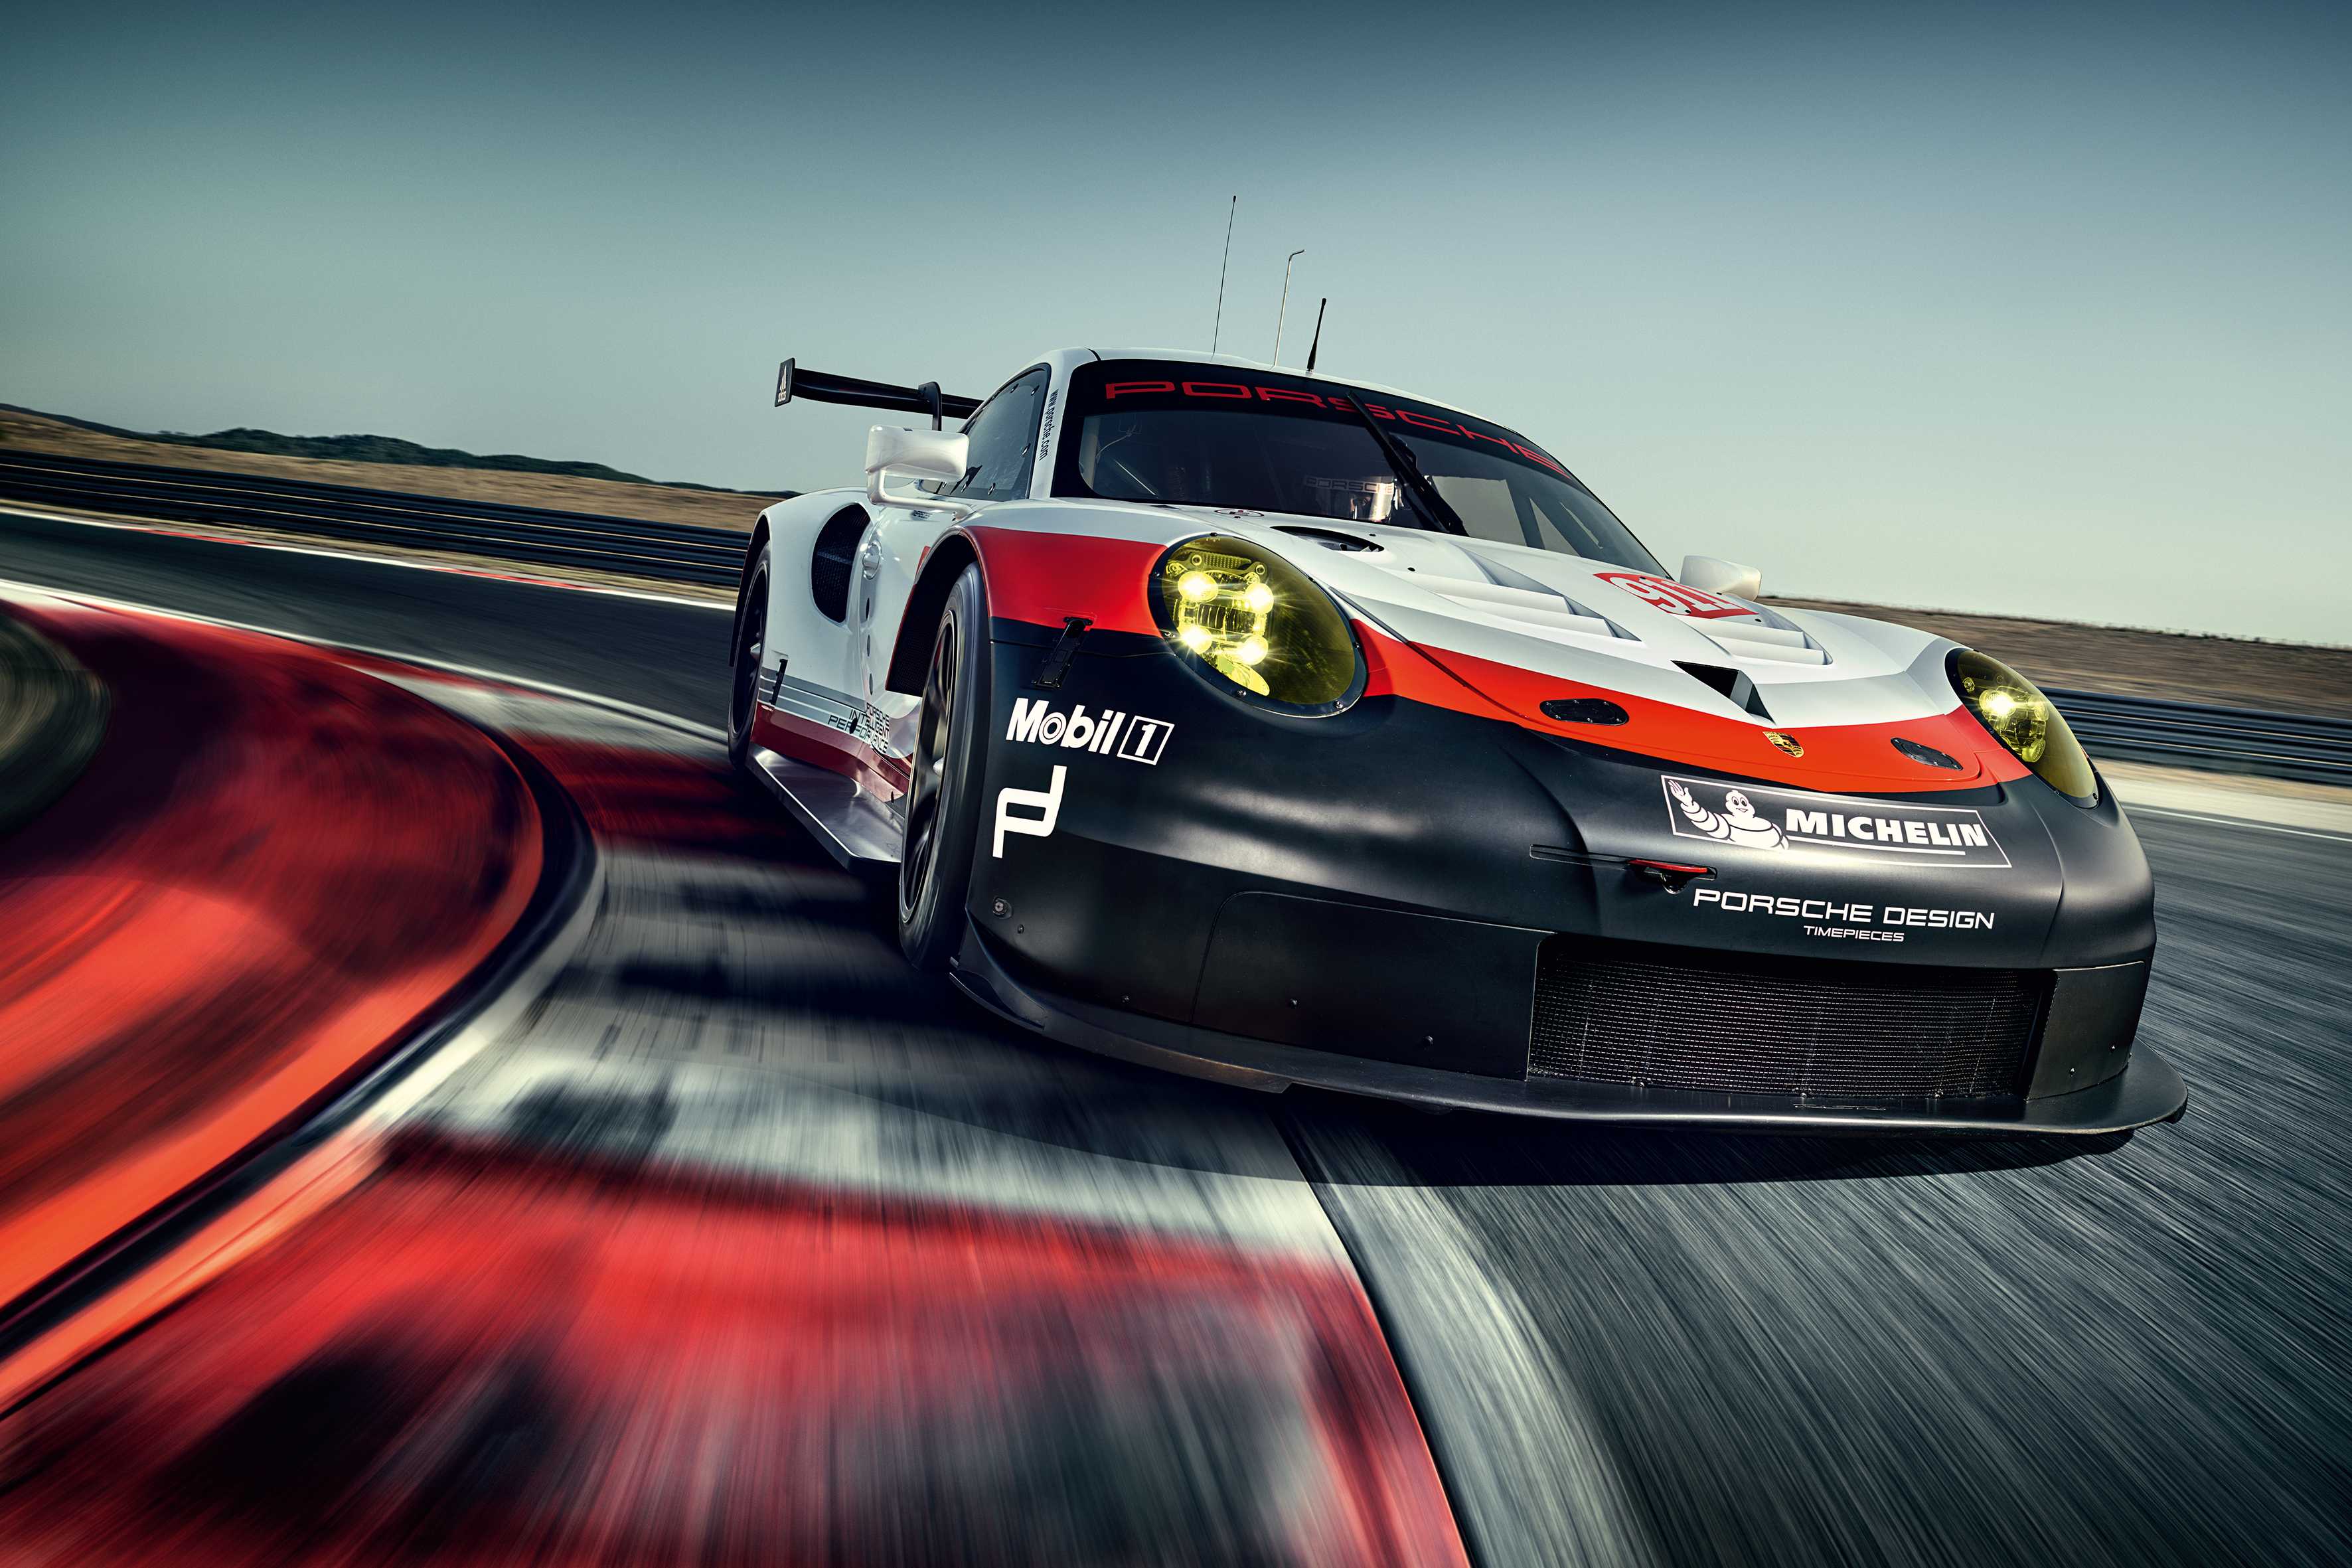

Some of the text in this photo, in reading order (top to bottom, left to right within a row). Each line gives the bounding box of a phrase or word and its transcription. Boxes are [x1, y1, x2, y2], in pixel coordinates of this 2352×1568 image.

[1039, 388, 1059, 461] www.porsche.com
[1106, 381, 1571, 479] PORSCHE
[1306, 476, 1393, 494] PORSCHE
[1609, 577, 1744, 615] 911
[849, 708, 890, 739] INTELLIGENT
[866, 702, 890, 726] PORSCHE
[1006, 698, 1126, 755] Mobil
[1786, 809, 1988, 846] MICHELIN
[1693, 888, 1995, 929] PORSCHE DESIGN
[1803, 925, 1905, 942] TIMEPIECES
